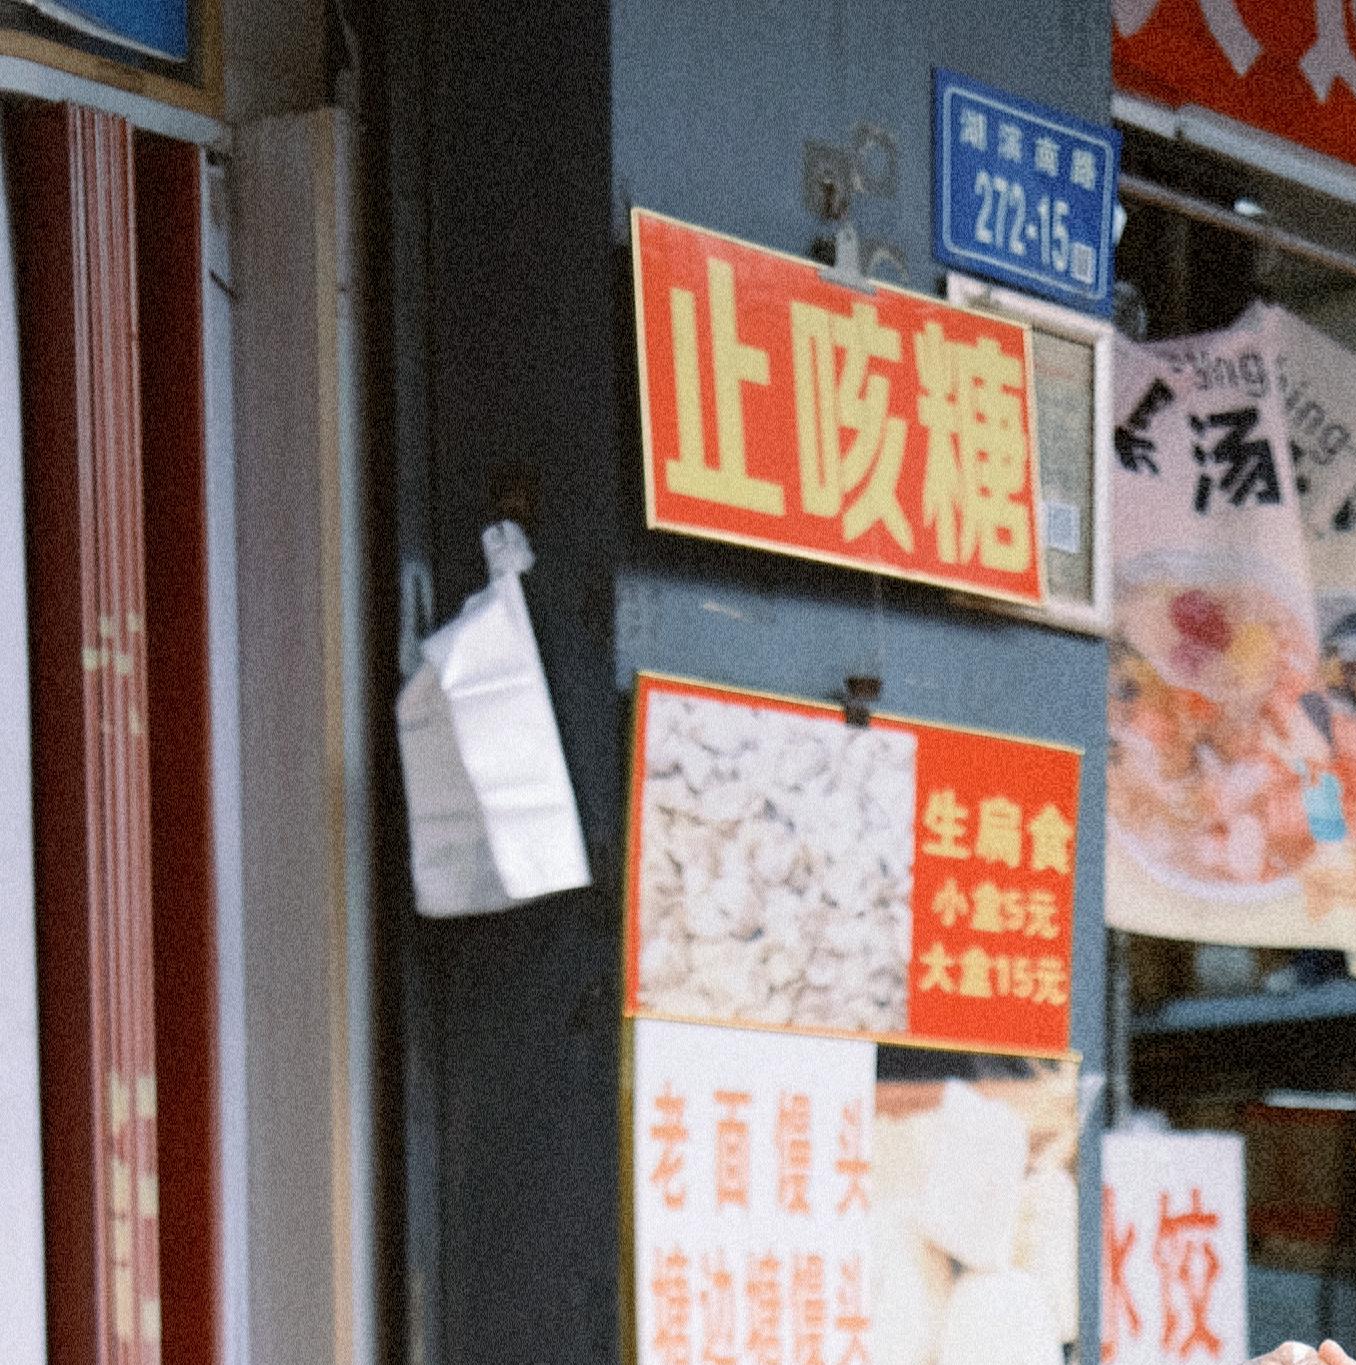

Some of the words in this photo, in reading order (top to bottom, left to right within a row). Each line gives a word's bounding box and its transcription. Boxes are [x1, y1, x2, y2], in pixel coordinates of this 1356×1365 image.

[974, 170, 1070, 272] 272-15
[665, 256, 1031, 573] 止咳糖
[930, 876, 1062, 940] 小盒5元
[918, 942, 1068, 1006] 大盒15元
[649, 1082, 872, 1214] 老面馒头
